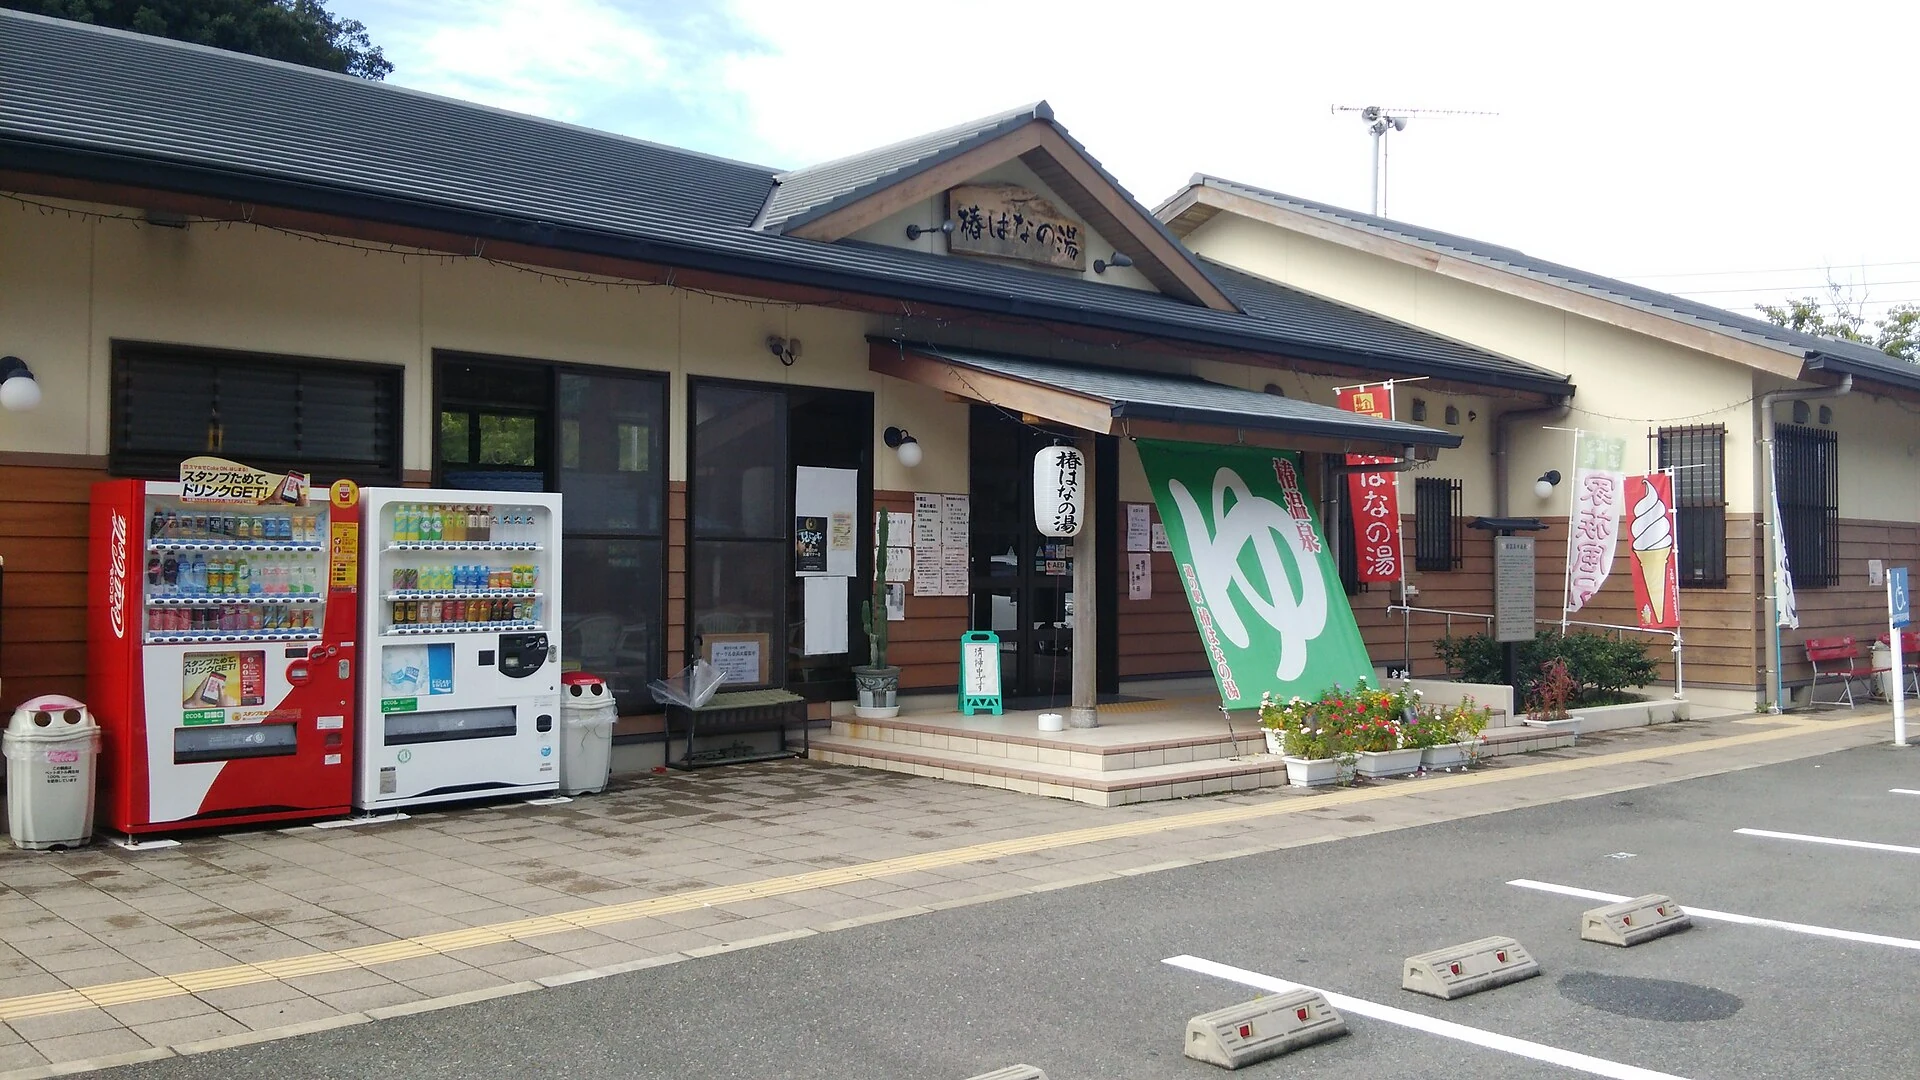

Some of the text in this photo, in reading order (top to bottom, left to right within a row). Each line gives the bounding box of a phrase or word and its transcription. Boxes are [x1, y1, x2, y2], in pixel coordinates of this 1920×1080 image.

[958, 204, 1079, 261] 椿はなの湯
[183, 470, 269, 485] スタンプためて、
[183, 483, 268, 499] ドリンクGET!
[1054, 451, 1083, 534] 椿はなの湯
[1273, 457, 1321, 553] 椿温泉
[110, 506, 127, 639] Coca-Cola
[1168, 466, 1328, 682] ゆ
[184, 662, 237, 676] ドリンクGET!
[1196, 606, 1241, 700] 椿はなの湯
